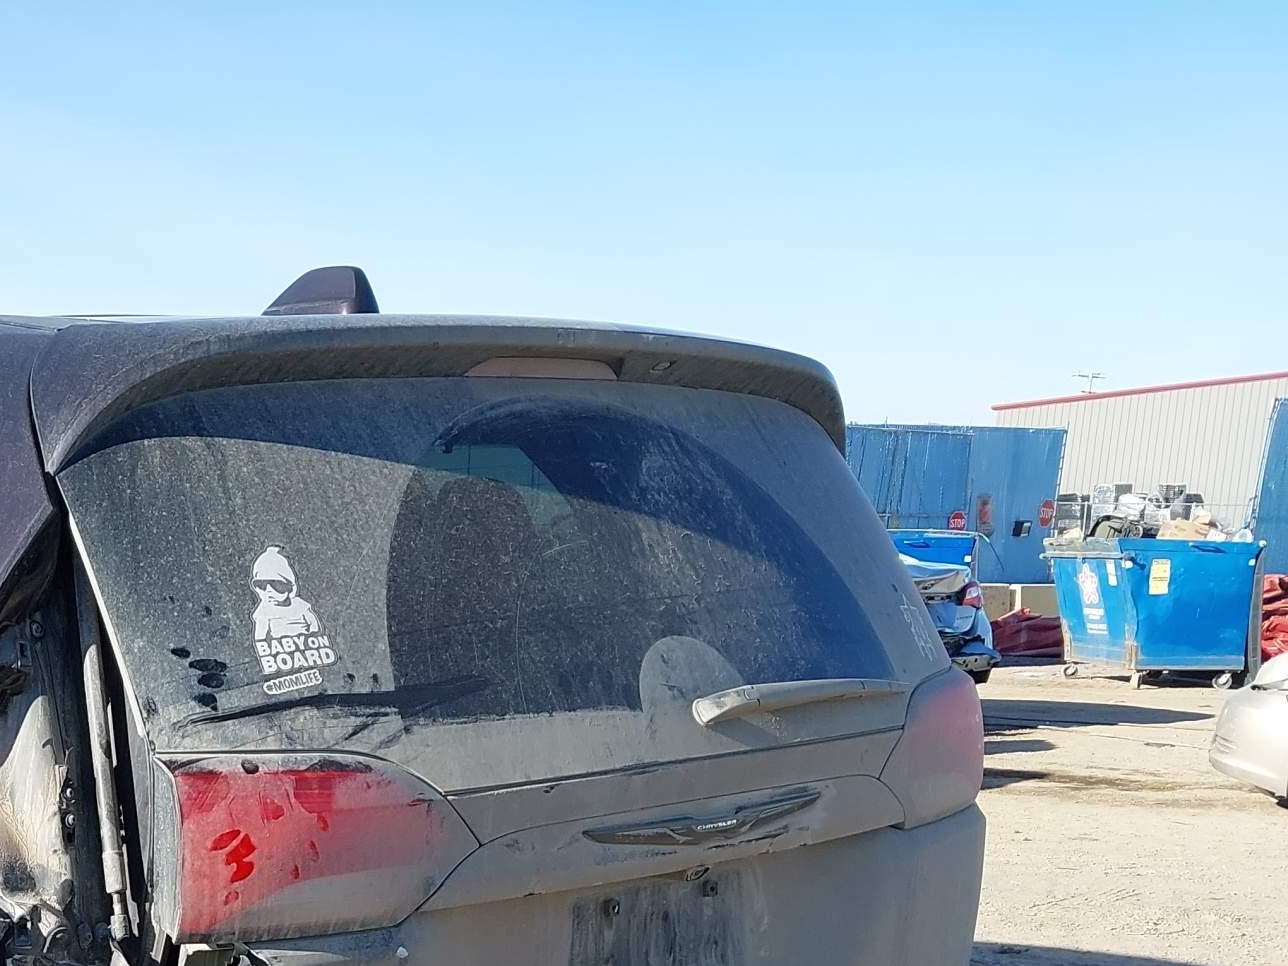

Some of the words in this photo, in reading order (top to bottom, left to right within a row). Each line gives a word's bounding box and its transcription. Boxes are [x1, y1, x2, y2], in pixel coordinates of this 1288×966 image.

[1039, 507, 1053, 519] STOP
[950, 519, 965, 529] STOP
[256, 636, 305, 656] BABY
[308, 635, 330, 648] ON
[261, 648, 335, 674] BOARD
[265, 671, 321, 692] #MOMLIFE
